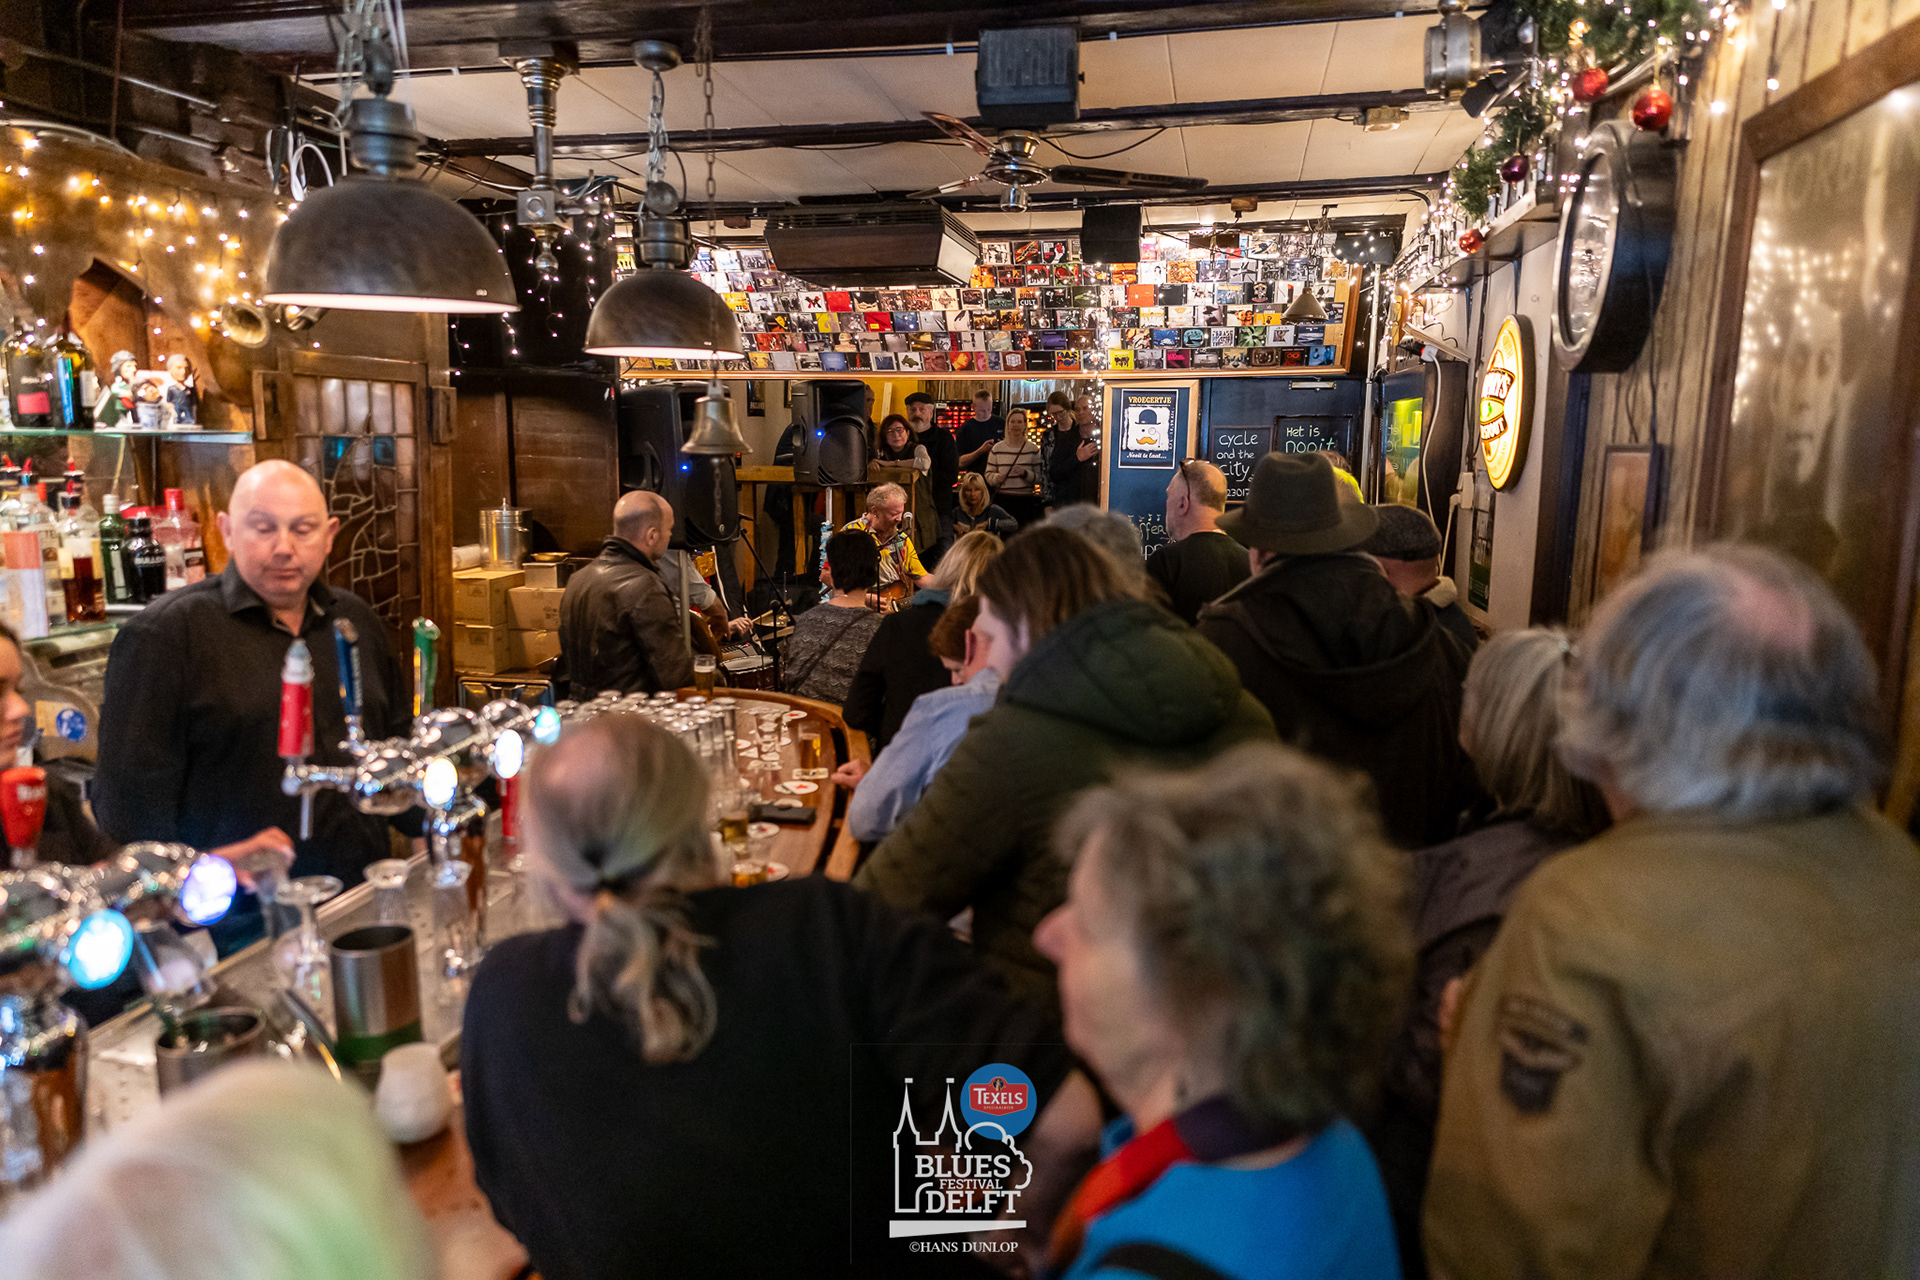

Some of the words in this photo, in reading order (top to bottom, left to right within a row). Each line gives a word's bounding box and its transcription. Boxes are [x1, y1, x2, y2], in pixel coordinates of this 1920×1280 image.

[1286, 427, 1305, 437] Het
[1308, 425, 1321, 437] is
[1218, 431, 1259, 448] cycle
[1237, 448, 1256, 460] the
